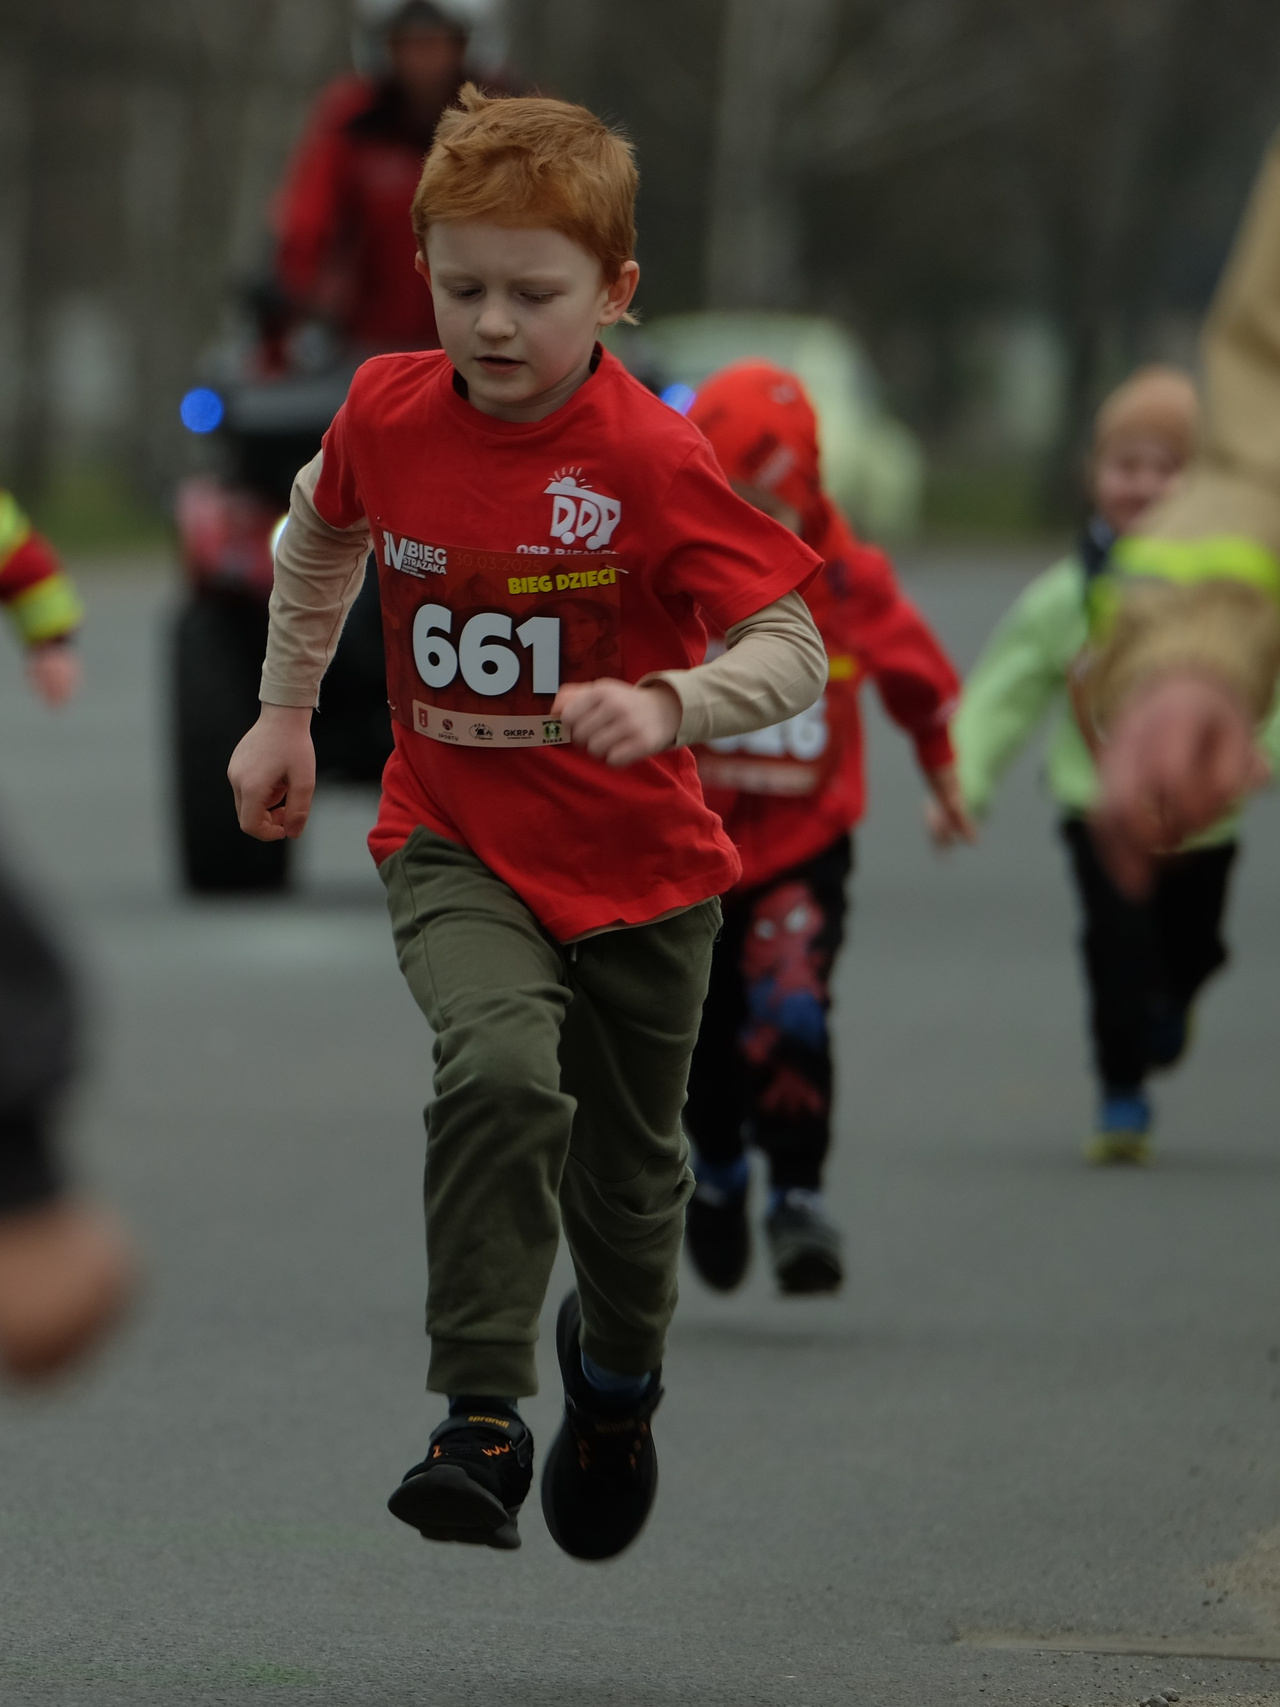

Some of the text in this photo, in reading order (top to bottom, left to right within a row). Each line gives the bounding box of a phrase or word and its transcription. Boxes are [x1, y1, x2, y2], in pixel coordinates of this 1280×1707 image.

[406, 540, 447, 565] BIEG
[454, 552, 543, 573] 30.03.2025
[402, 556, 447, 575] STRAŻAKA
[507, 568, 617, 595] BIEG DZIECI
[412, 603, 560, 696] 661
[503, 729, 535, 737] GKRPA
[468, 1415, 510, 1429] sprandi
